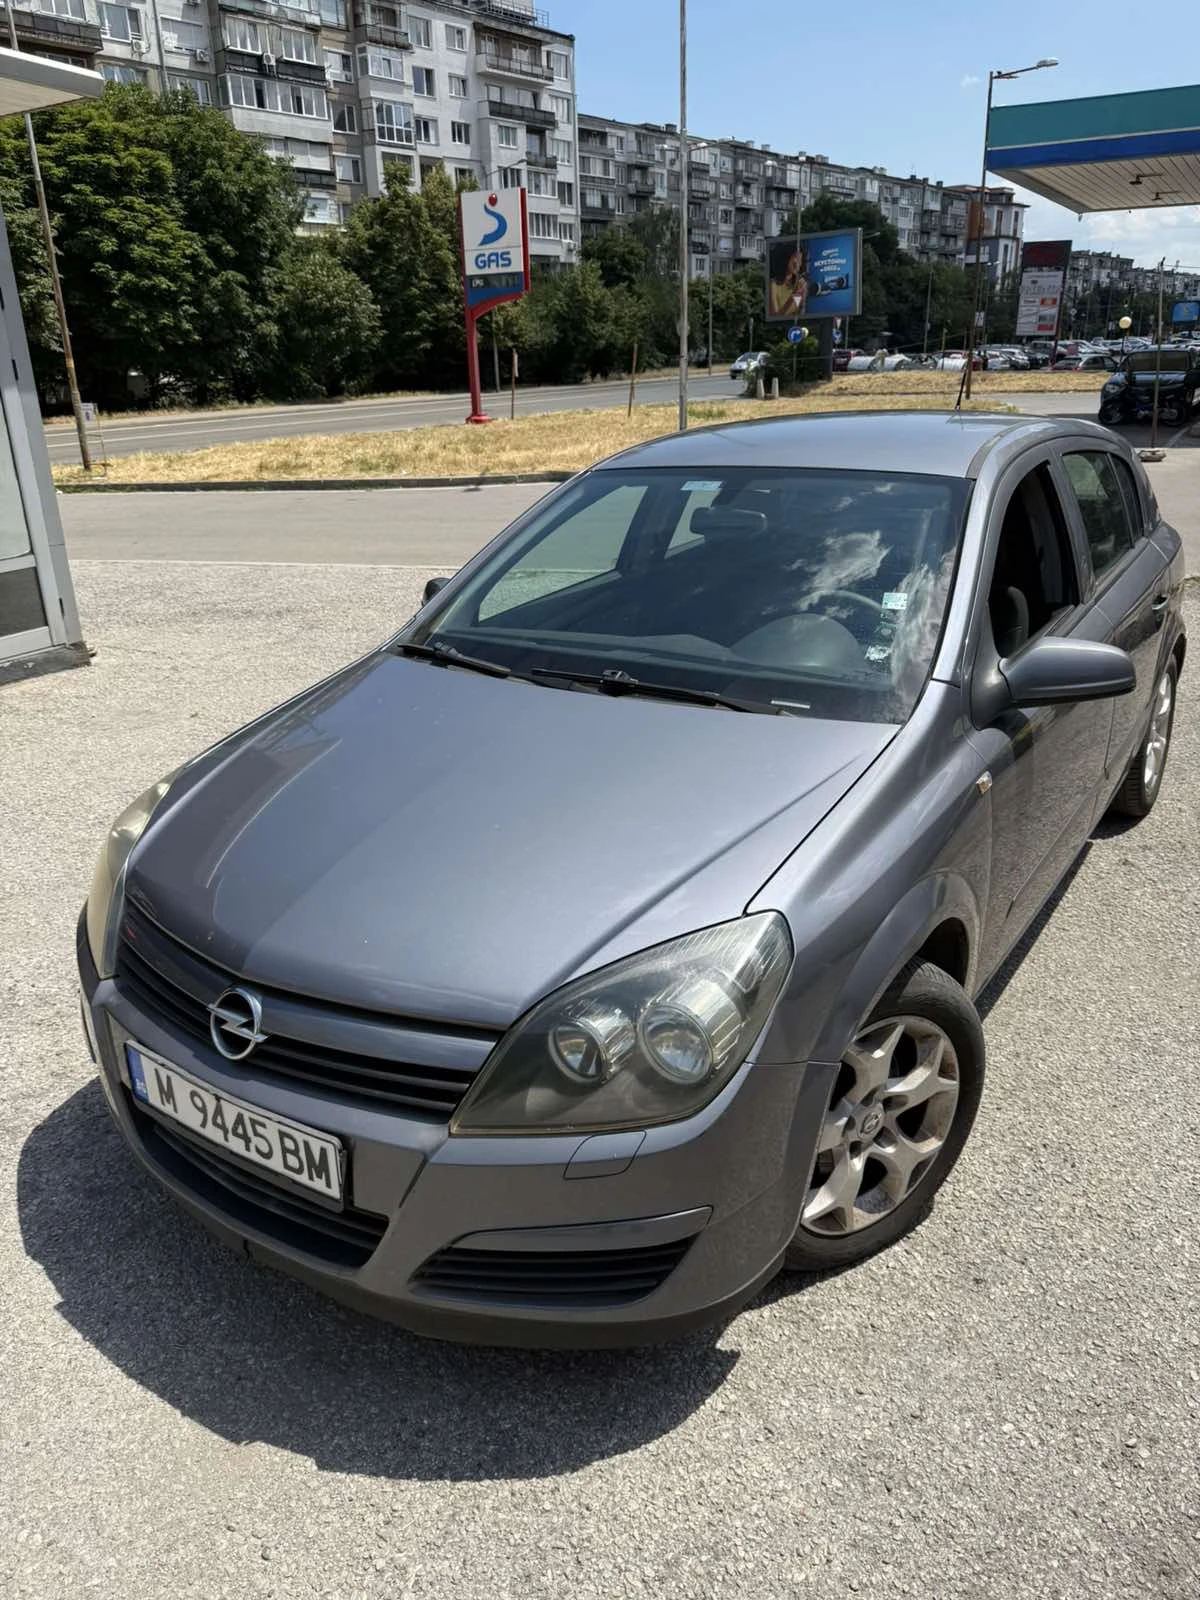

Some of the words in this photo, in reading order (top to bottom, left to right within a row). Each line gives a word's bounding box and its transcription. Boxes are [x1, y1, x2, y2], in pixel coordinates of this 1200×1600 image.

[475, 251, 511, 269] GAS
[154, 1068, 178, 1114] M
[189, 1090, 274, 1160] 9445
